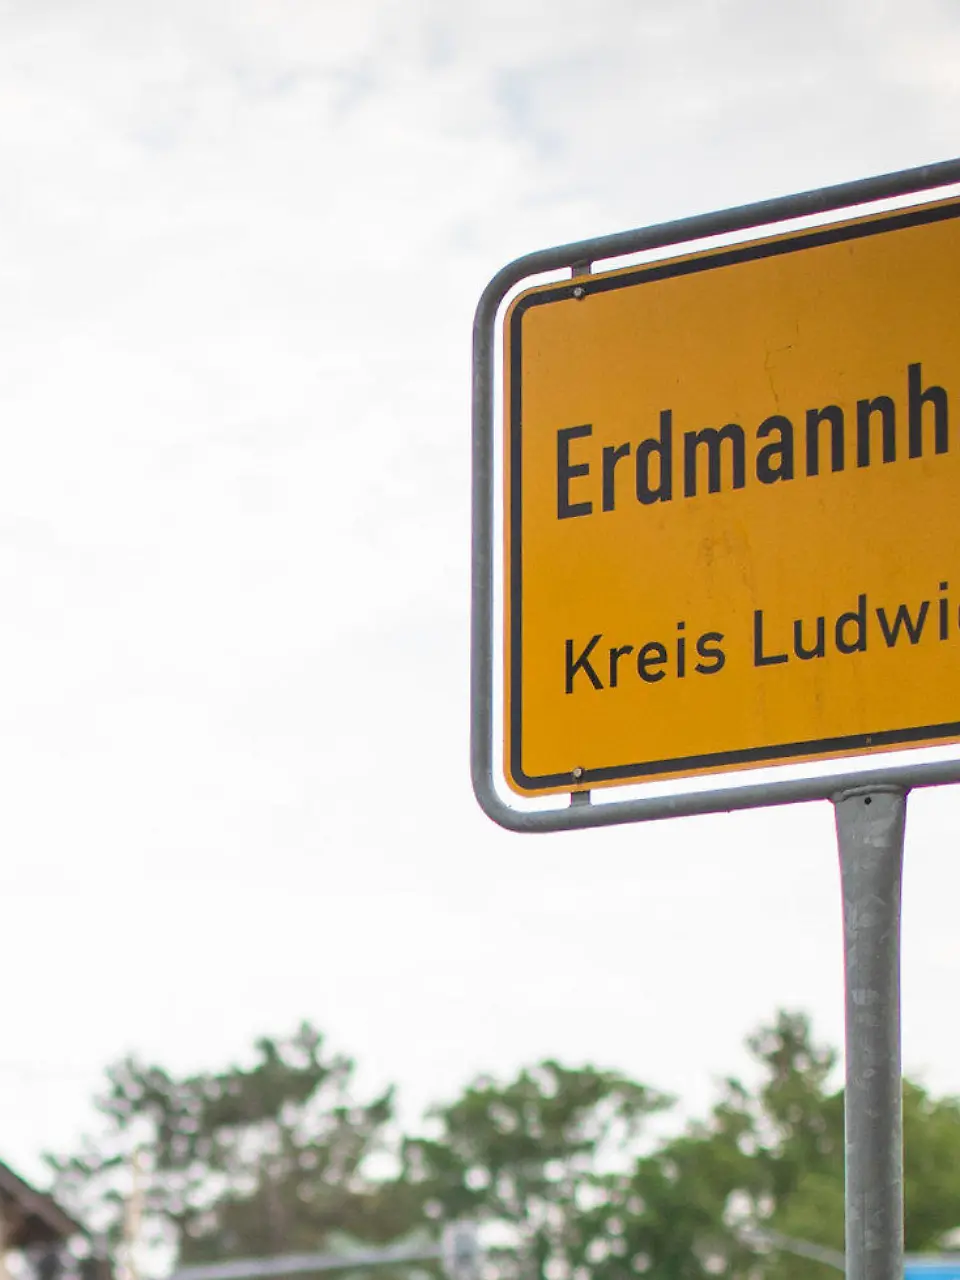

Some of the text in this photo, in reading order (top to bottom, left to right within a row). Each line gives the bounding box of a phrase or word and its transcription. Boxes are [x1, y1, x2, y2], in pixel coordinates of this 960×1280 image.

[557, 362, 949, 520] Erdmannh
[565, 581, 960, 694] Kreis Ludwi
